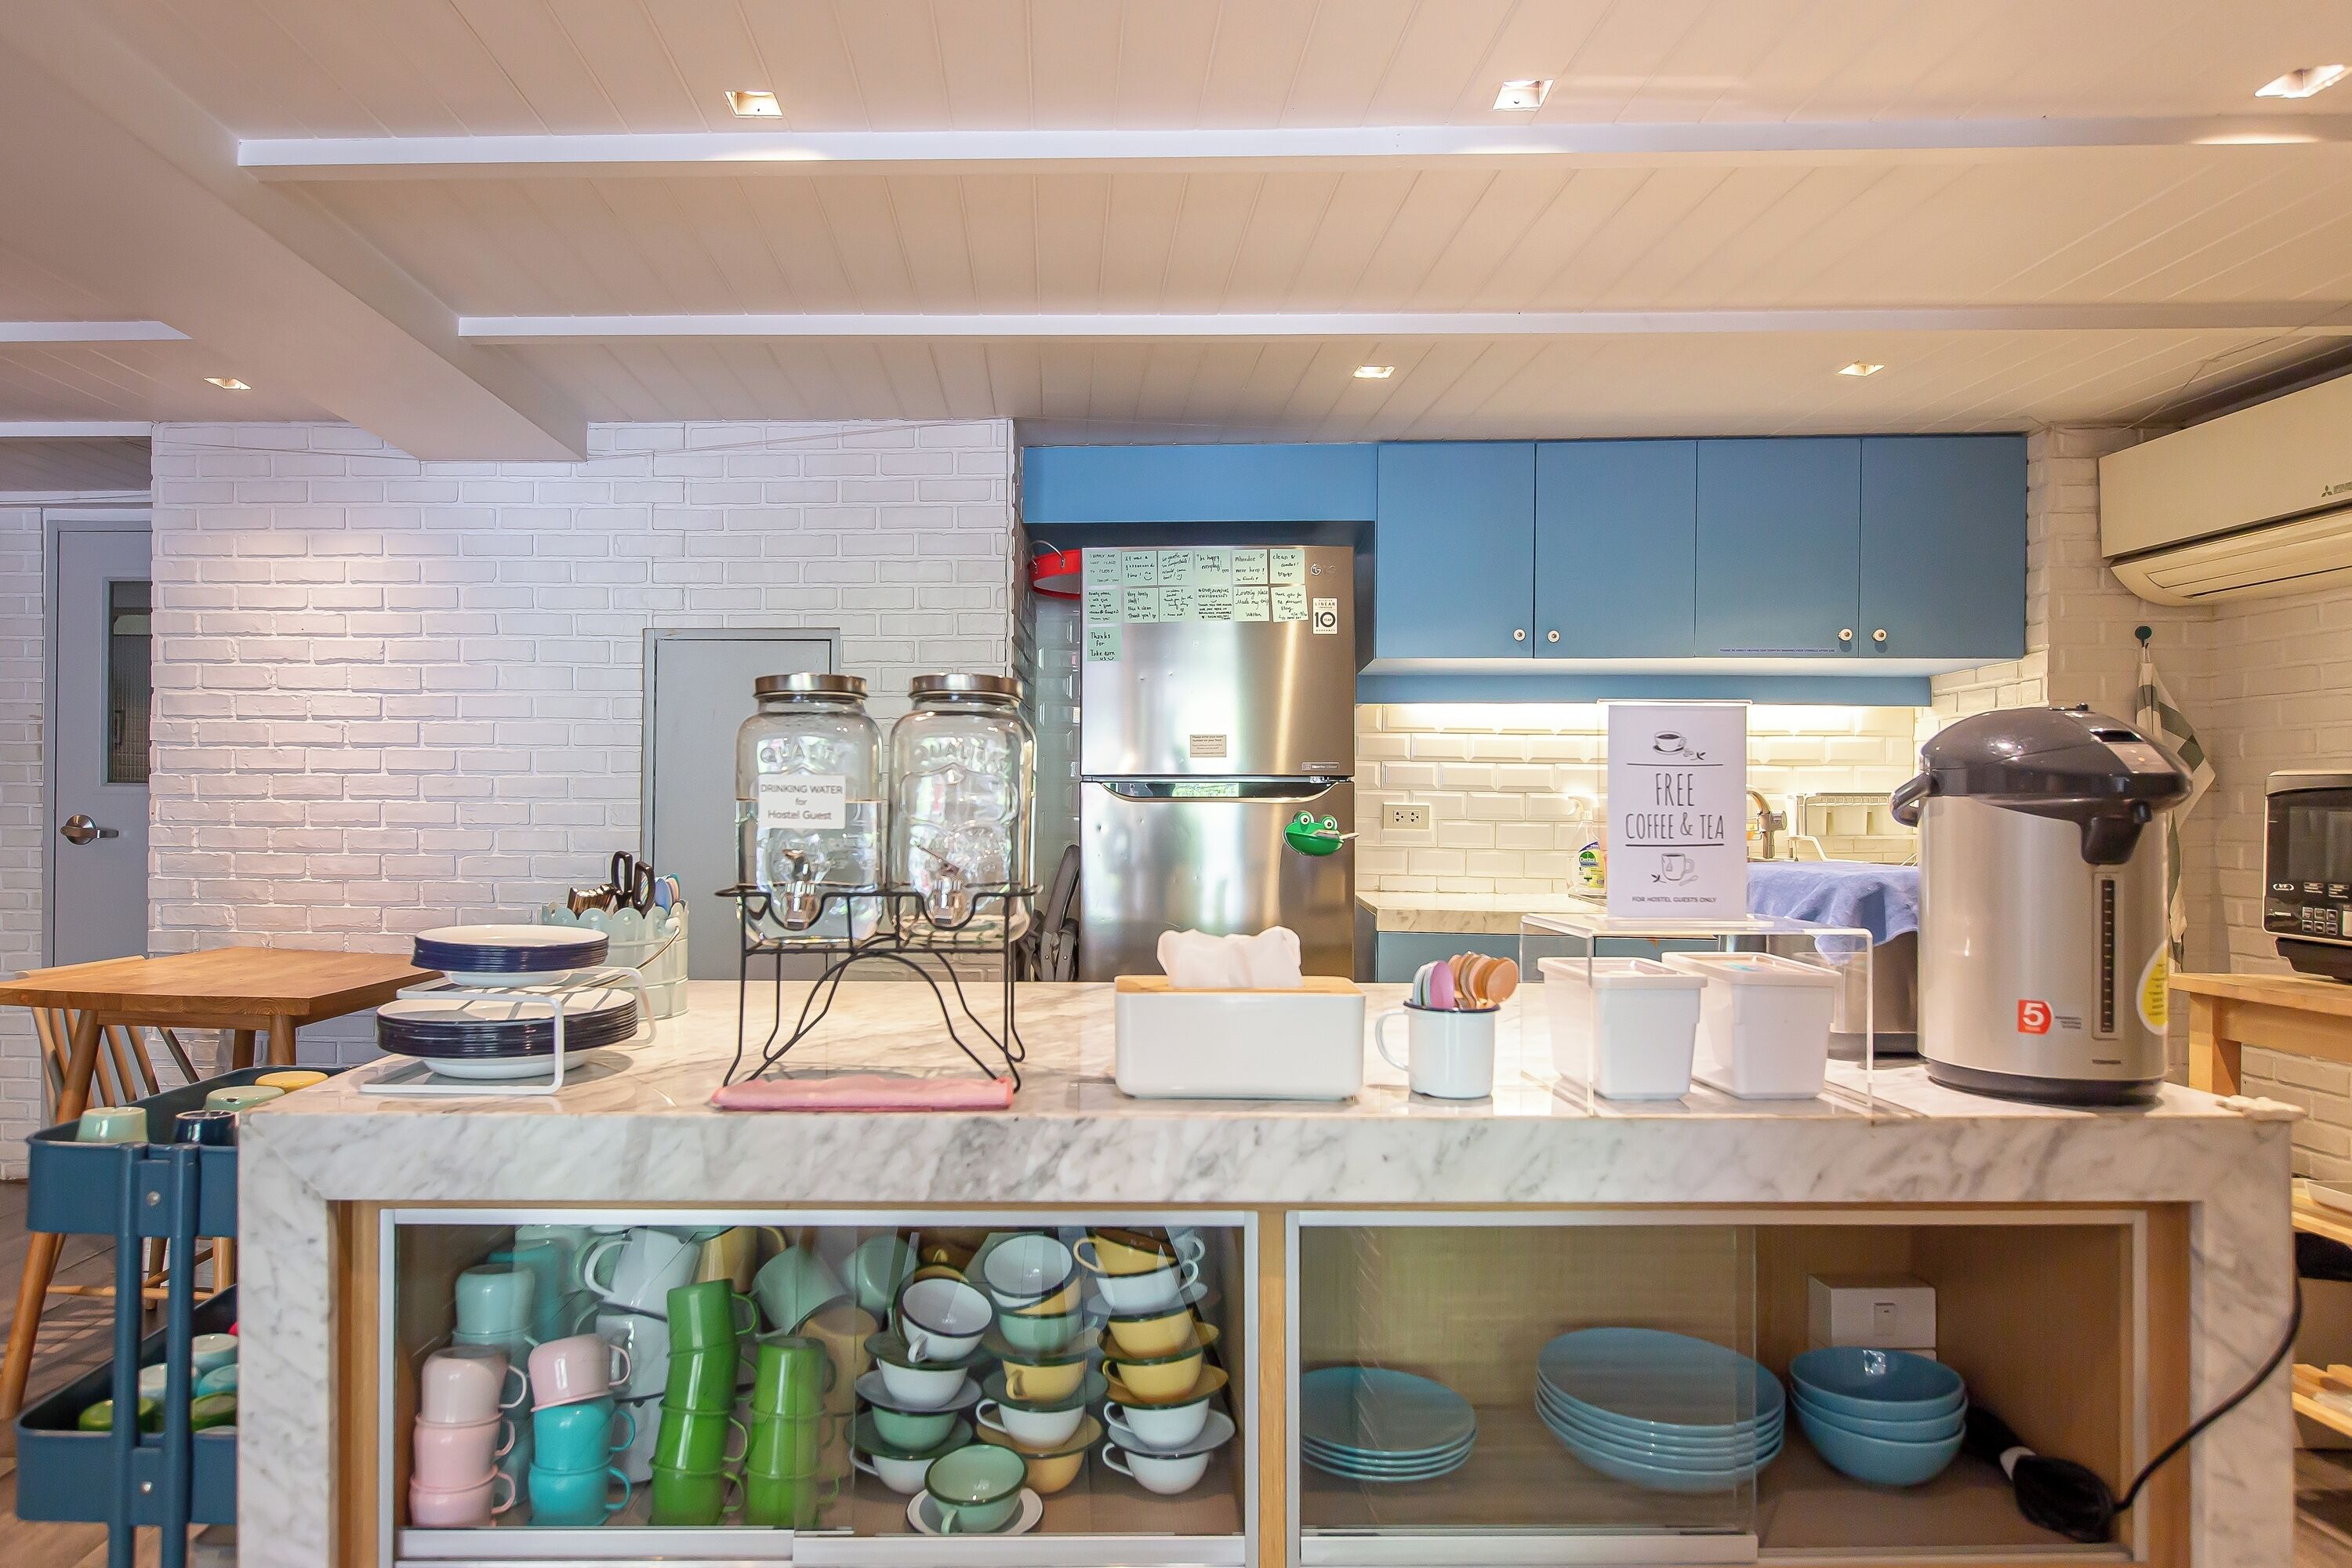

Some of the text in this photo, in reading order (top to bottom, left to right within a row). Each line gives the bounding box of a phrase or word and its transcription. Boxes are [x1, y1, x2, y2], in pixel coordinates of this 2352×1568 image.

[1236, 589, 1256, 599] Lovely
[1251, 601, 1259, 610] my
[1315, 612, 1336, 627] 10
[1091, 631, 1111, 640] Thanks
[760, 784, 843, 794] DRINKING WATER
[1656, 773, 1695, 806] FREE
[768, 810, 832, 820] Hostel Guest
[1625, 812, 1724, 840] COFFEE & TEA
[2023, 1002, 2045, 1027] 5
